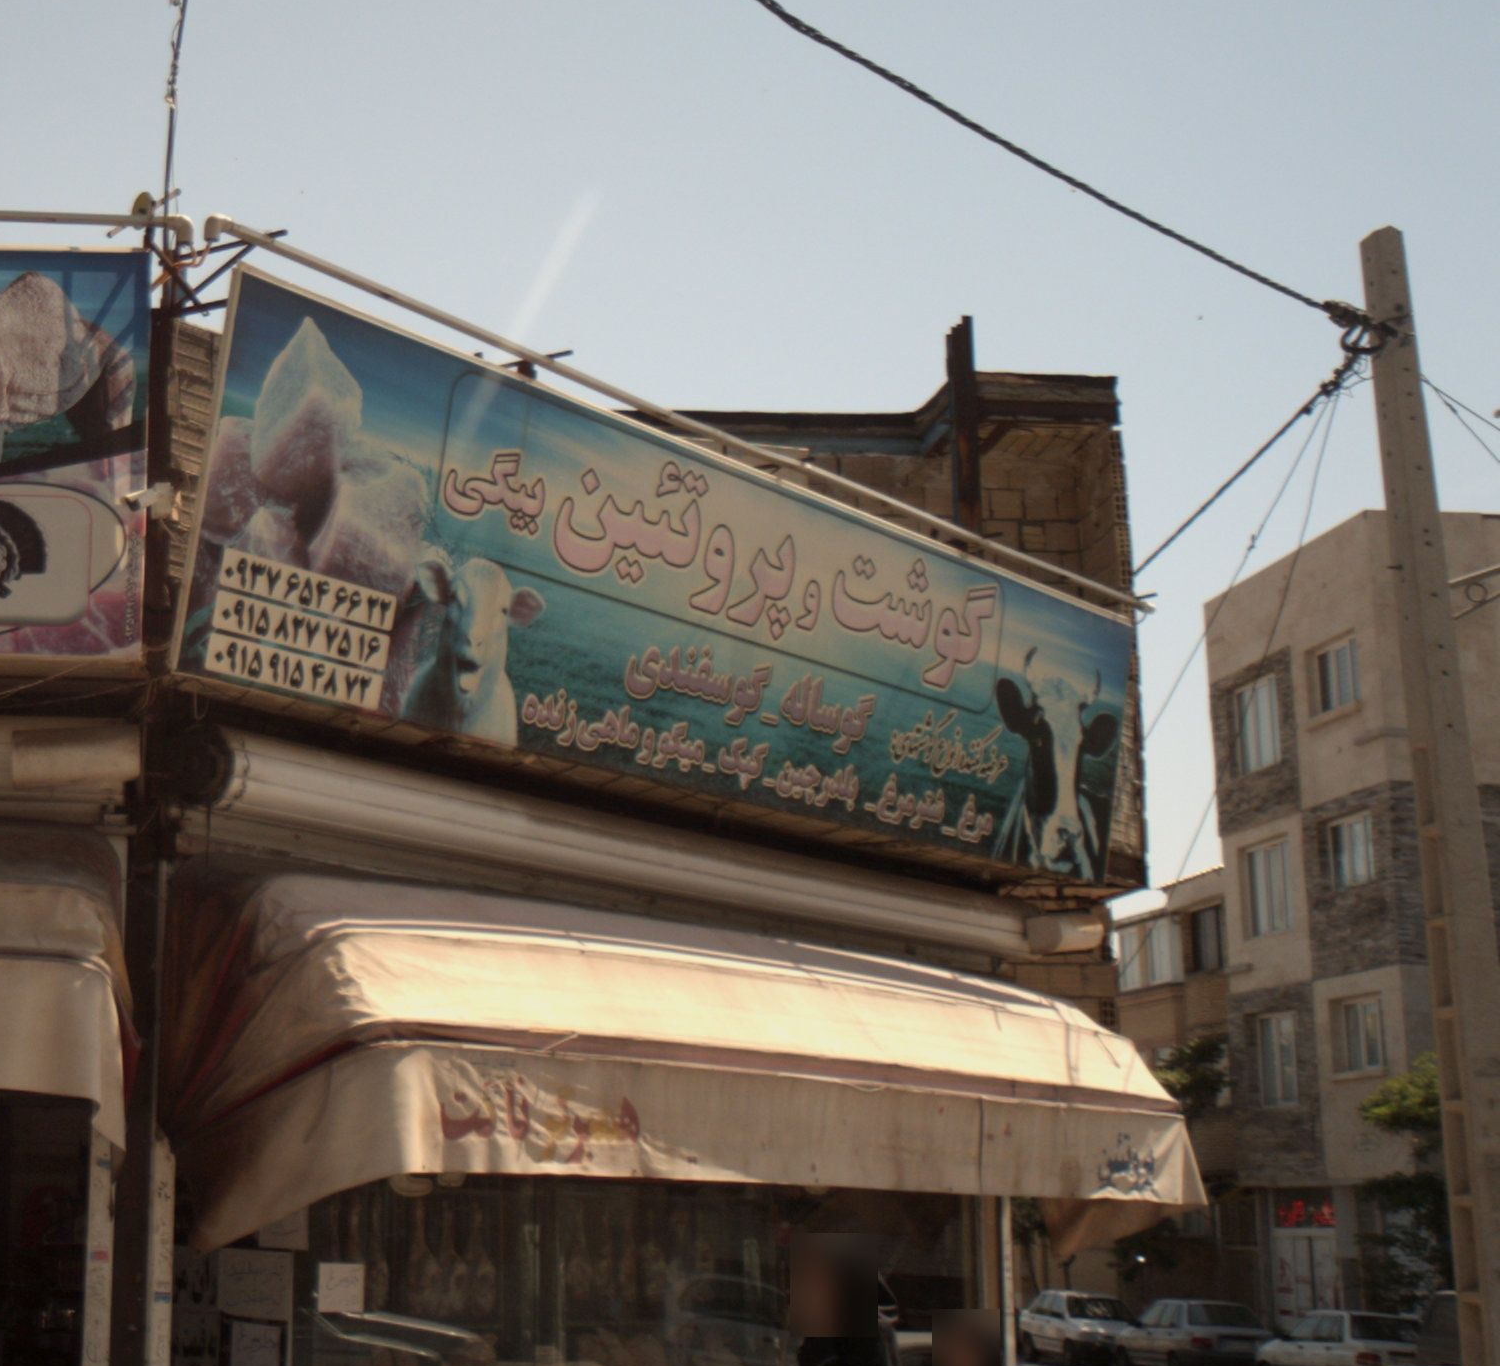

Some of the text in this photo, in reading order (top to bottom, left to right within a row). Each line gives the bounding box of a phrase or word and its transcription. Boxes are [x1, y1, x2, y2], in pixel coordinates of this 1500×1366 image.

[224, 557, 282, 596] ۰۹۳۷
[283, 573, 331, 609] ۶۵۴
[332, 586, 363, 618] ۶۶
[443, 452, 998, 690] گوشت و پروتئین بیگی
[221, 599, 272, 637] ۰۹۱۵
[324, 624, 353, 658] ۷۵
[358, 632, 382, 664] ۱۶
[213, 641, 264, 679] ۰۹۱۵
[268, 652, 306, 689] ۹۱۵
[310, 662, 339, 696] ۴۸
[522, 688, 578, 747] زنده
[576, 704, 640, 751] ماهی
[624, 644, 877, 755] گوساله گوسفندی
[635, 727, 655, 766] و
[652, 721, 705, 773] میگو
[776, 760, 860, 812] بلدرچین
[876, 772, 945, 830] شترمرغ
[956, 793, 993, 843] مرغ
